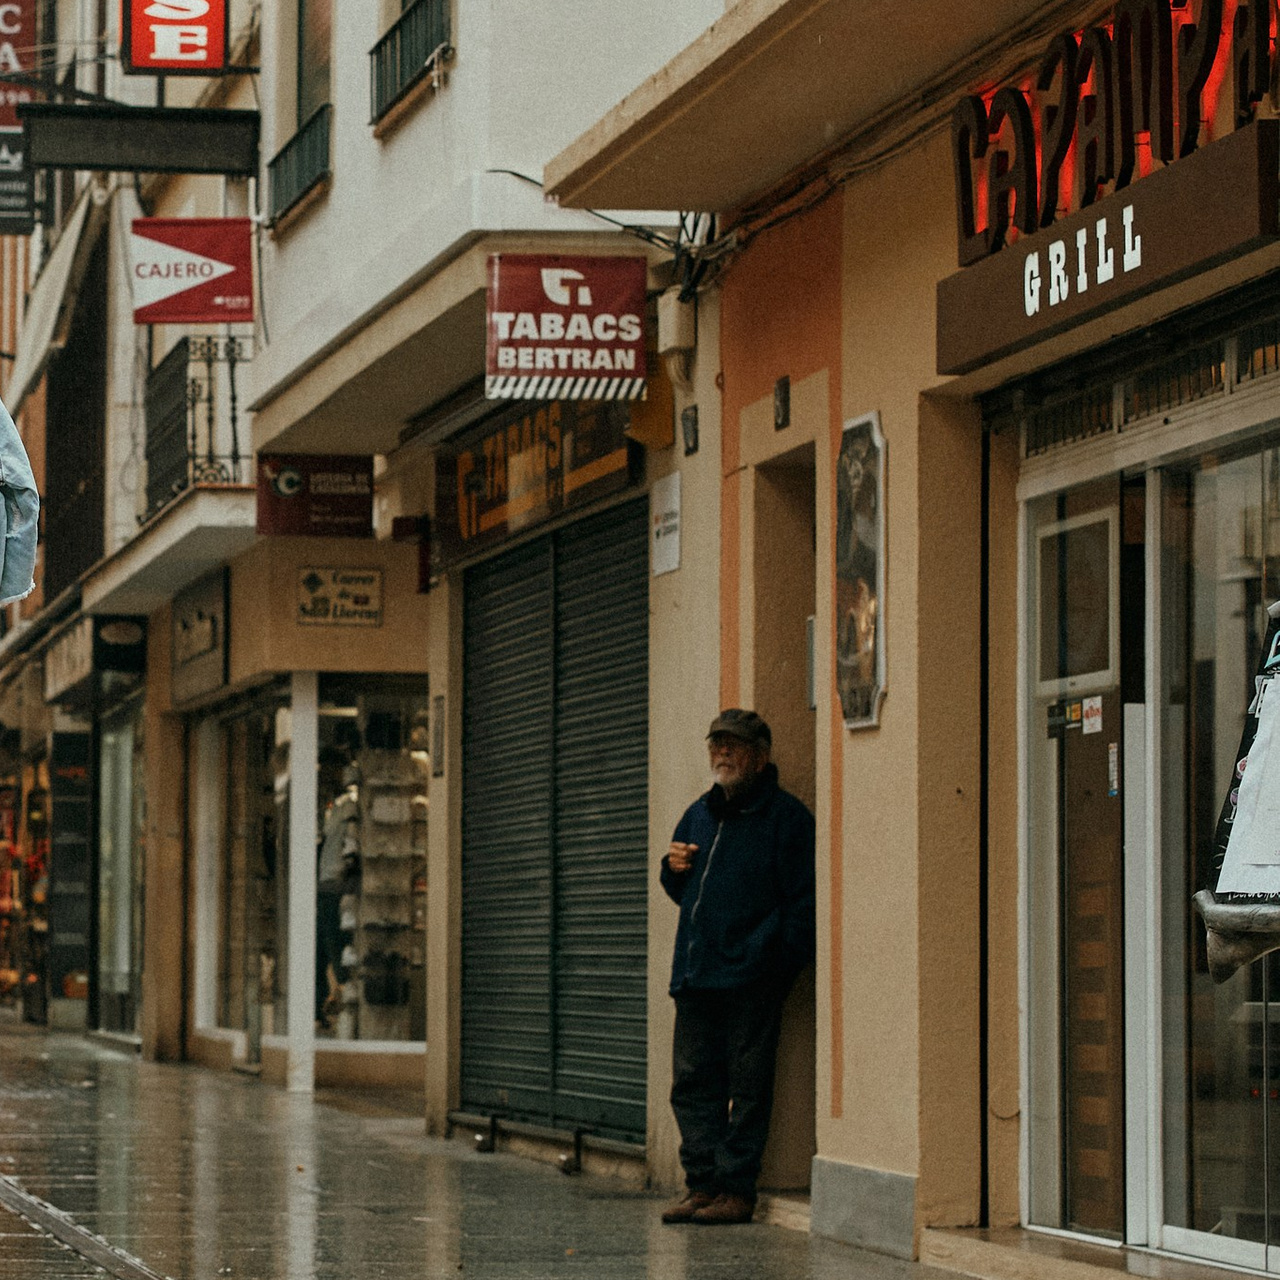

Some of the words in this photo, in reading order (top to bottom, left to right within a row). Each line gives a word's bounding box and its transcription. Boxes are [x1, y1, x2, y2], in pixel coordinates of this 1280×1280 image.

[135, 262, 214, 279] CAJERO
[1023, 203, 1142, 317] GRILL
[491, 312, 642, 342] TABACS
[497, 346, 636, 370] BERTRAN
